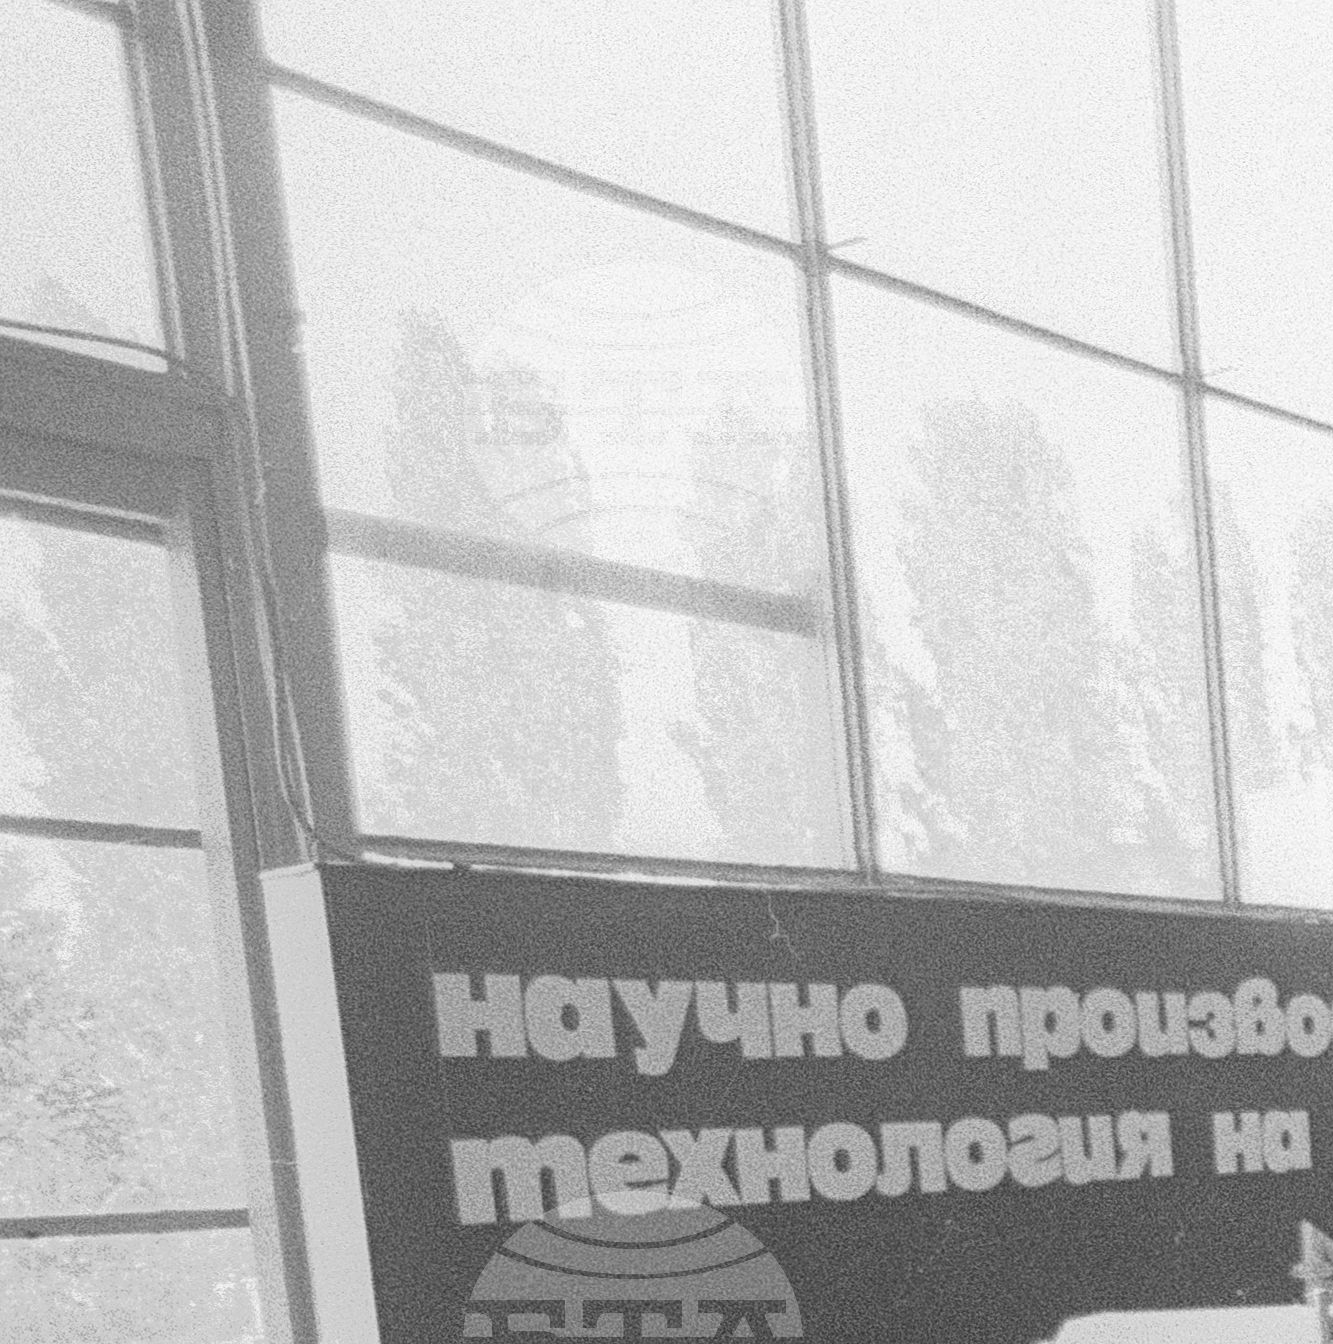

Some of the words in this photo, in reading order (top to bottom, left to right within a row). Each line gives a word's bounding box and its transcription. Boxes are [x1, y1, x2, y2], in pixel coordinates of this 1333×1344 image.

[432, 972, 908, 1076] научно
[450, 1109, 1174, 1225] технология
[1212, 1109, 1311, 1175] на
